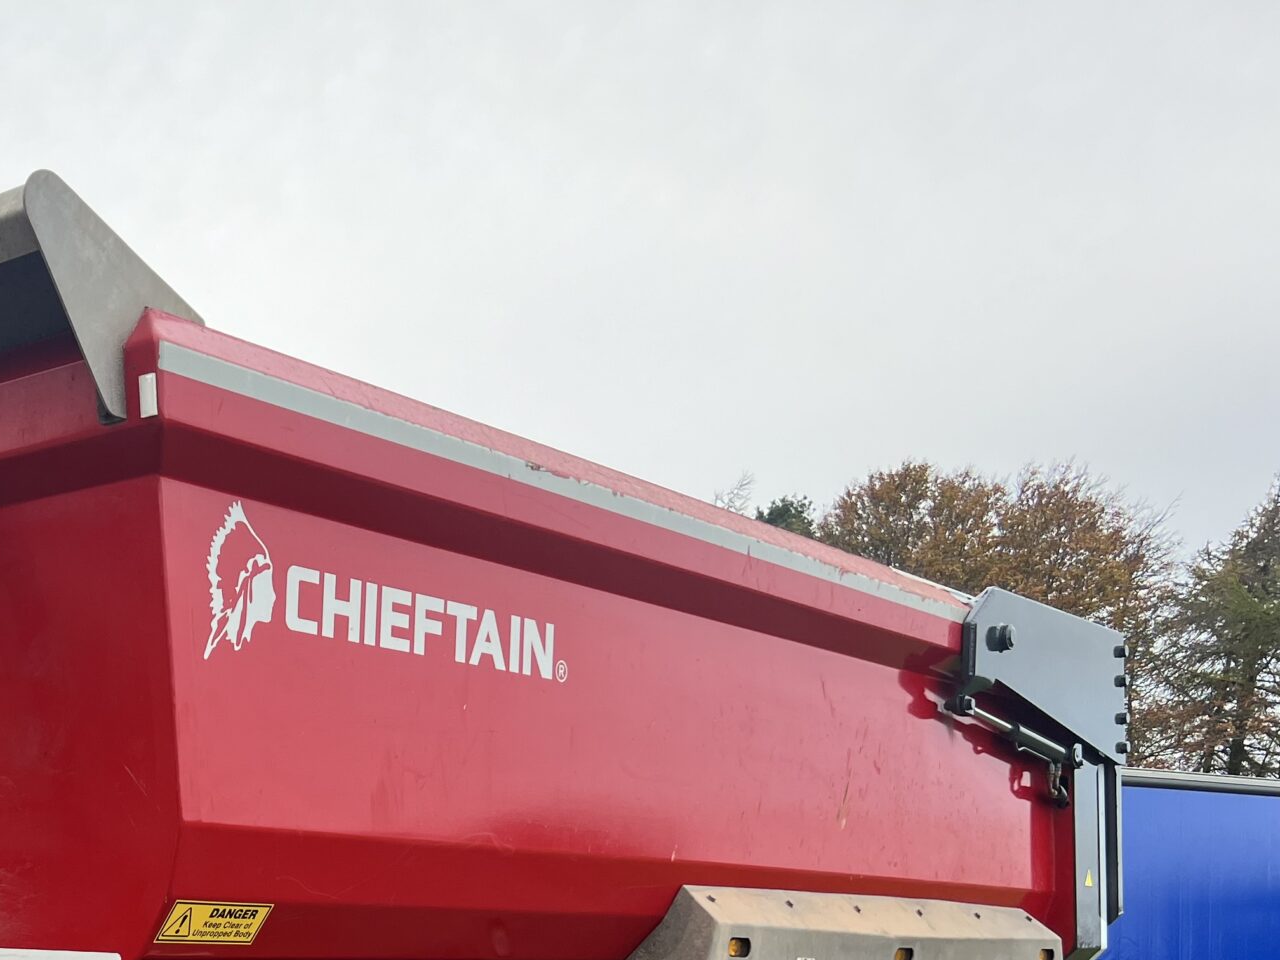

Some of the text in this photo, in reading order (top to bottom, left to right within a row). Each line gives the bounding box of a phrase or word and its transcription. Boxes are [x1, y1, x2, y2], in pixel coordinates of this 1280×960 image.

[285, 565, 554, 680] CHIEFTAIN
[209, 908, 259, 919] DANGER
[202, 921, 222, 930] Keep
[223, 921, 243, 929] Clear
[192, 929, 253, 939] Unpropped Body
